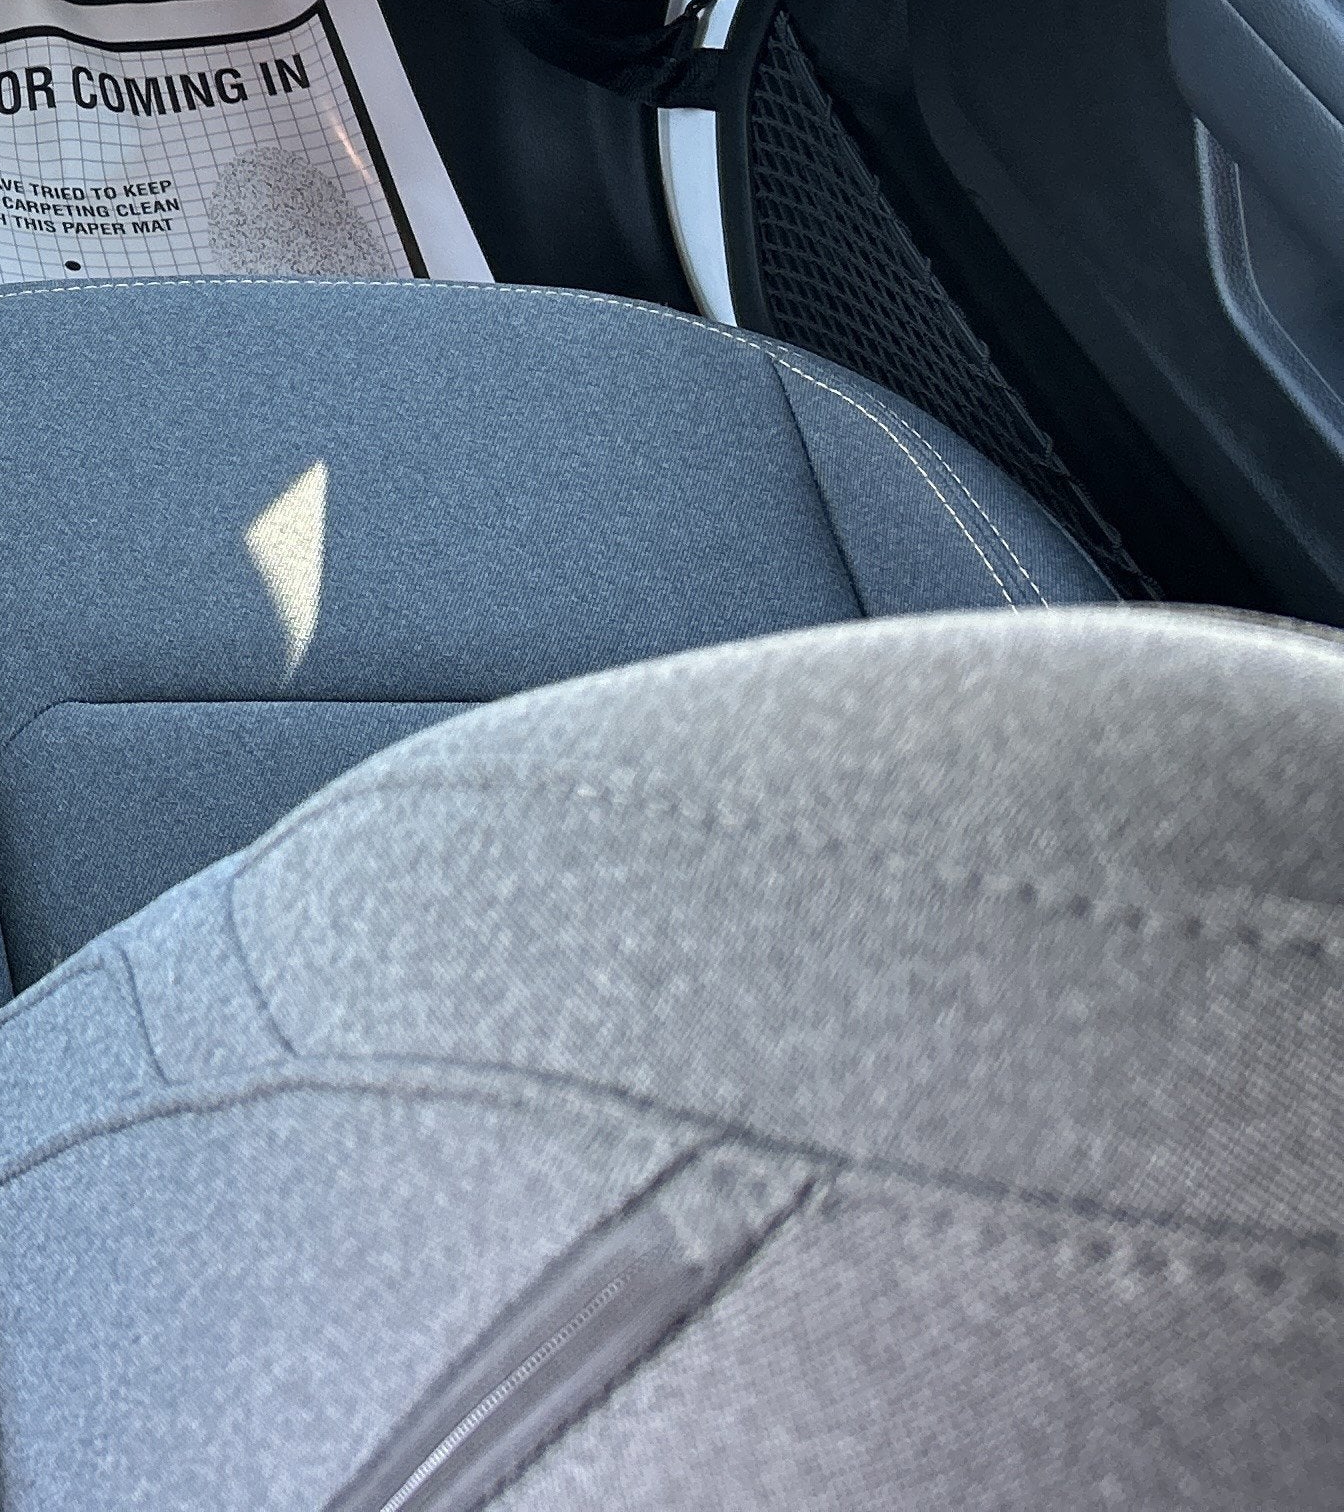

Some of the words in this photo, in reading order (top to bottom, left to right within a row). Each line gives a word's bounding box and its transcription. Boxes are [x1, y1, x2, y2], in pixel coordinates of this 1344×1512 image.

[72, 65, 248, 117] COMING
[259, 54, 311, 96] IN
[29, 183, 85, 201] TRIED
[93, 187, 117, 200] TO
[124, 180, 172, 198] KEEP
[2, 196, 110, 218] CARPETING
[116, 198, 180, 217] CLEAN
[14, 215, 57, 233] THIS
[62, 221, 126, 235] PAPER
[132, 218, 174, 235] MAT
